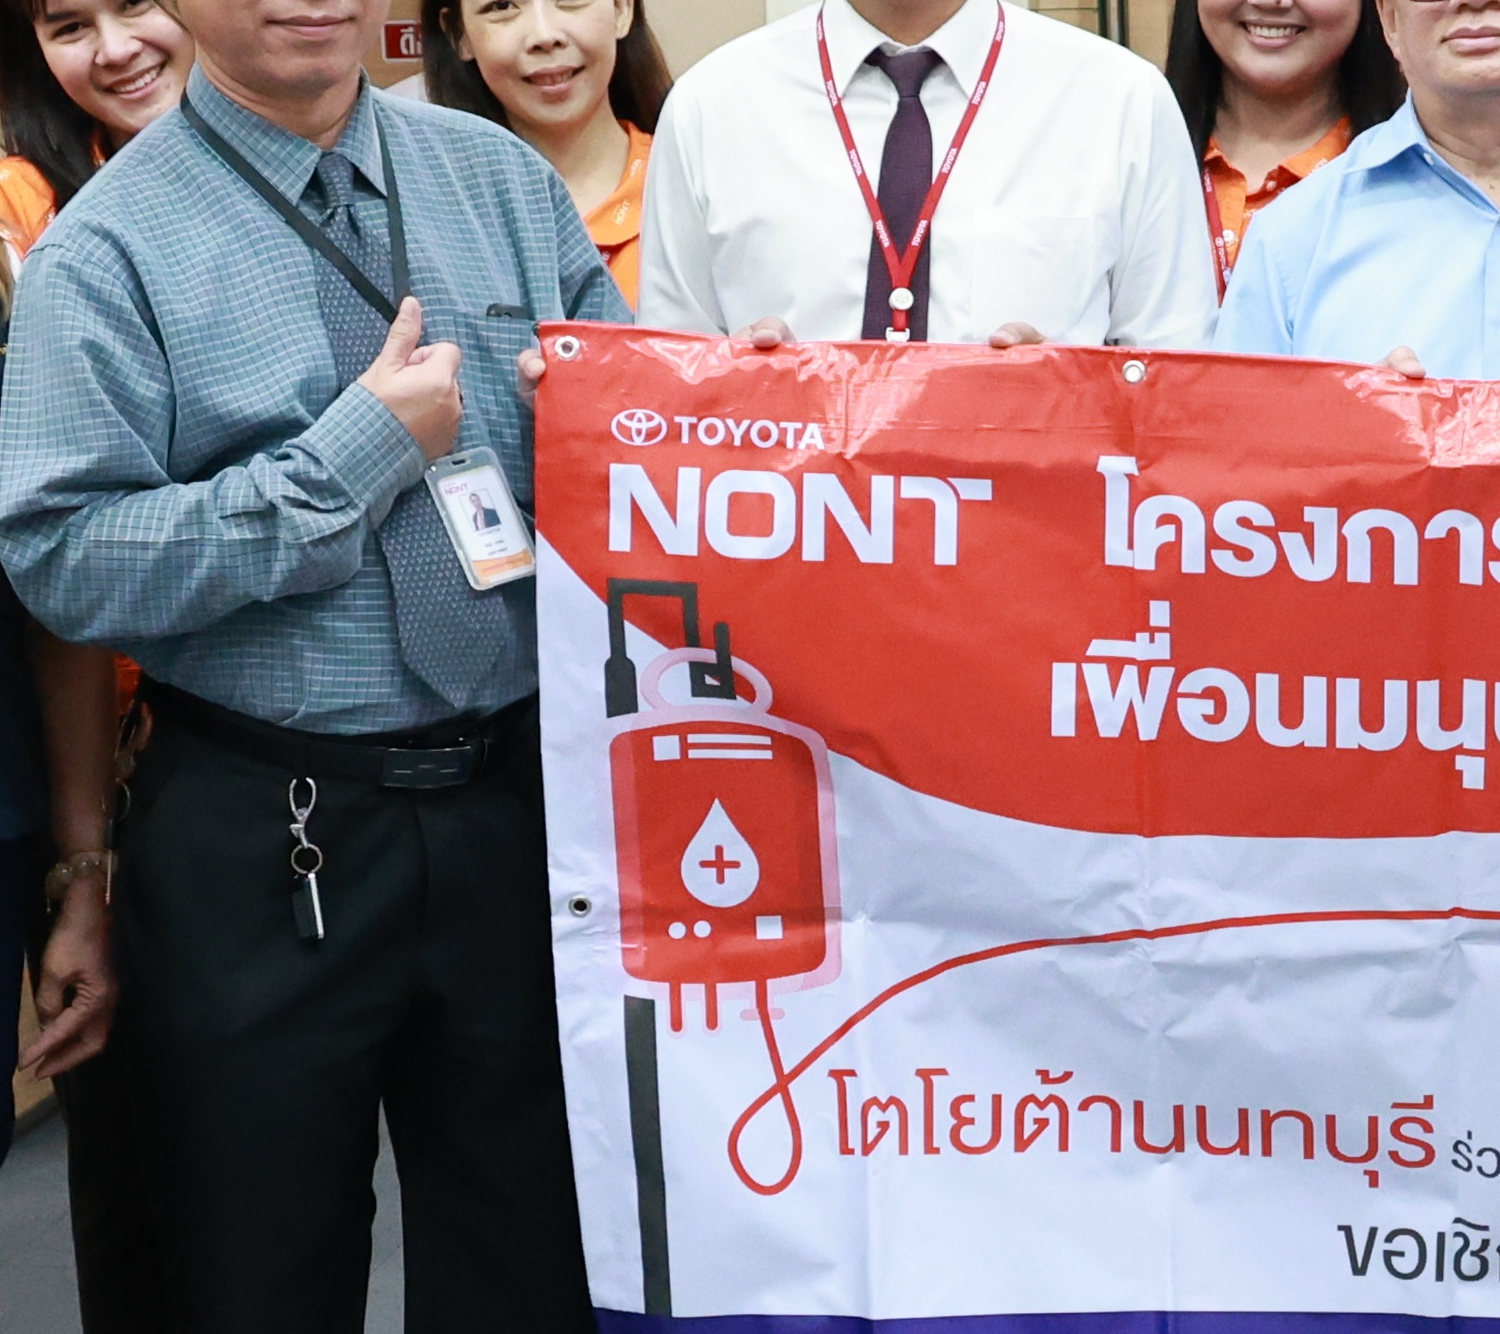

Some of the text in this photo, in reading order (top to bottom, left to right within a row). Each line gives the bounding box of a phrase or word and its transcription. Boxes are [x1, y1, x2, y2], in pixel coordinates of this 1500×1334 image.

[826, 79, 839, 107] TOYOTA
[971, 81, 987, 105] TOYOTA
[849, 148, 864, 177] TOYOTA
[941, 147, 958, 174] TOYOTA
[875, 219, 891, 248] TOYOTA
[911, 219, 928, 247] TOYOTA
[674, 415, 833, 453] TOYOTA
[609, 463, 993, 566] NONT
[831, 1069, 1436, 1187] โตโยต้านนทบุรี
